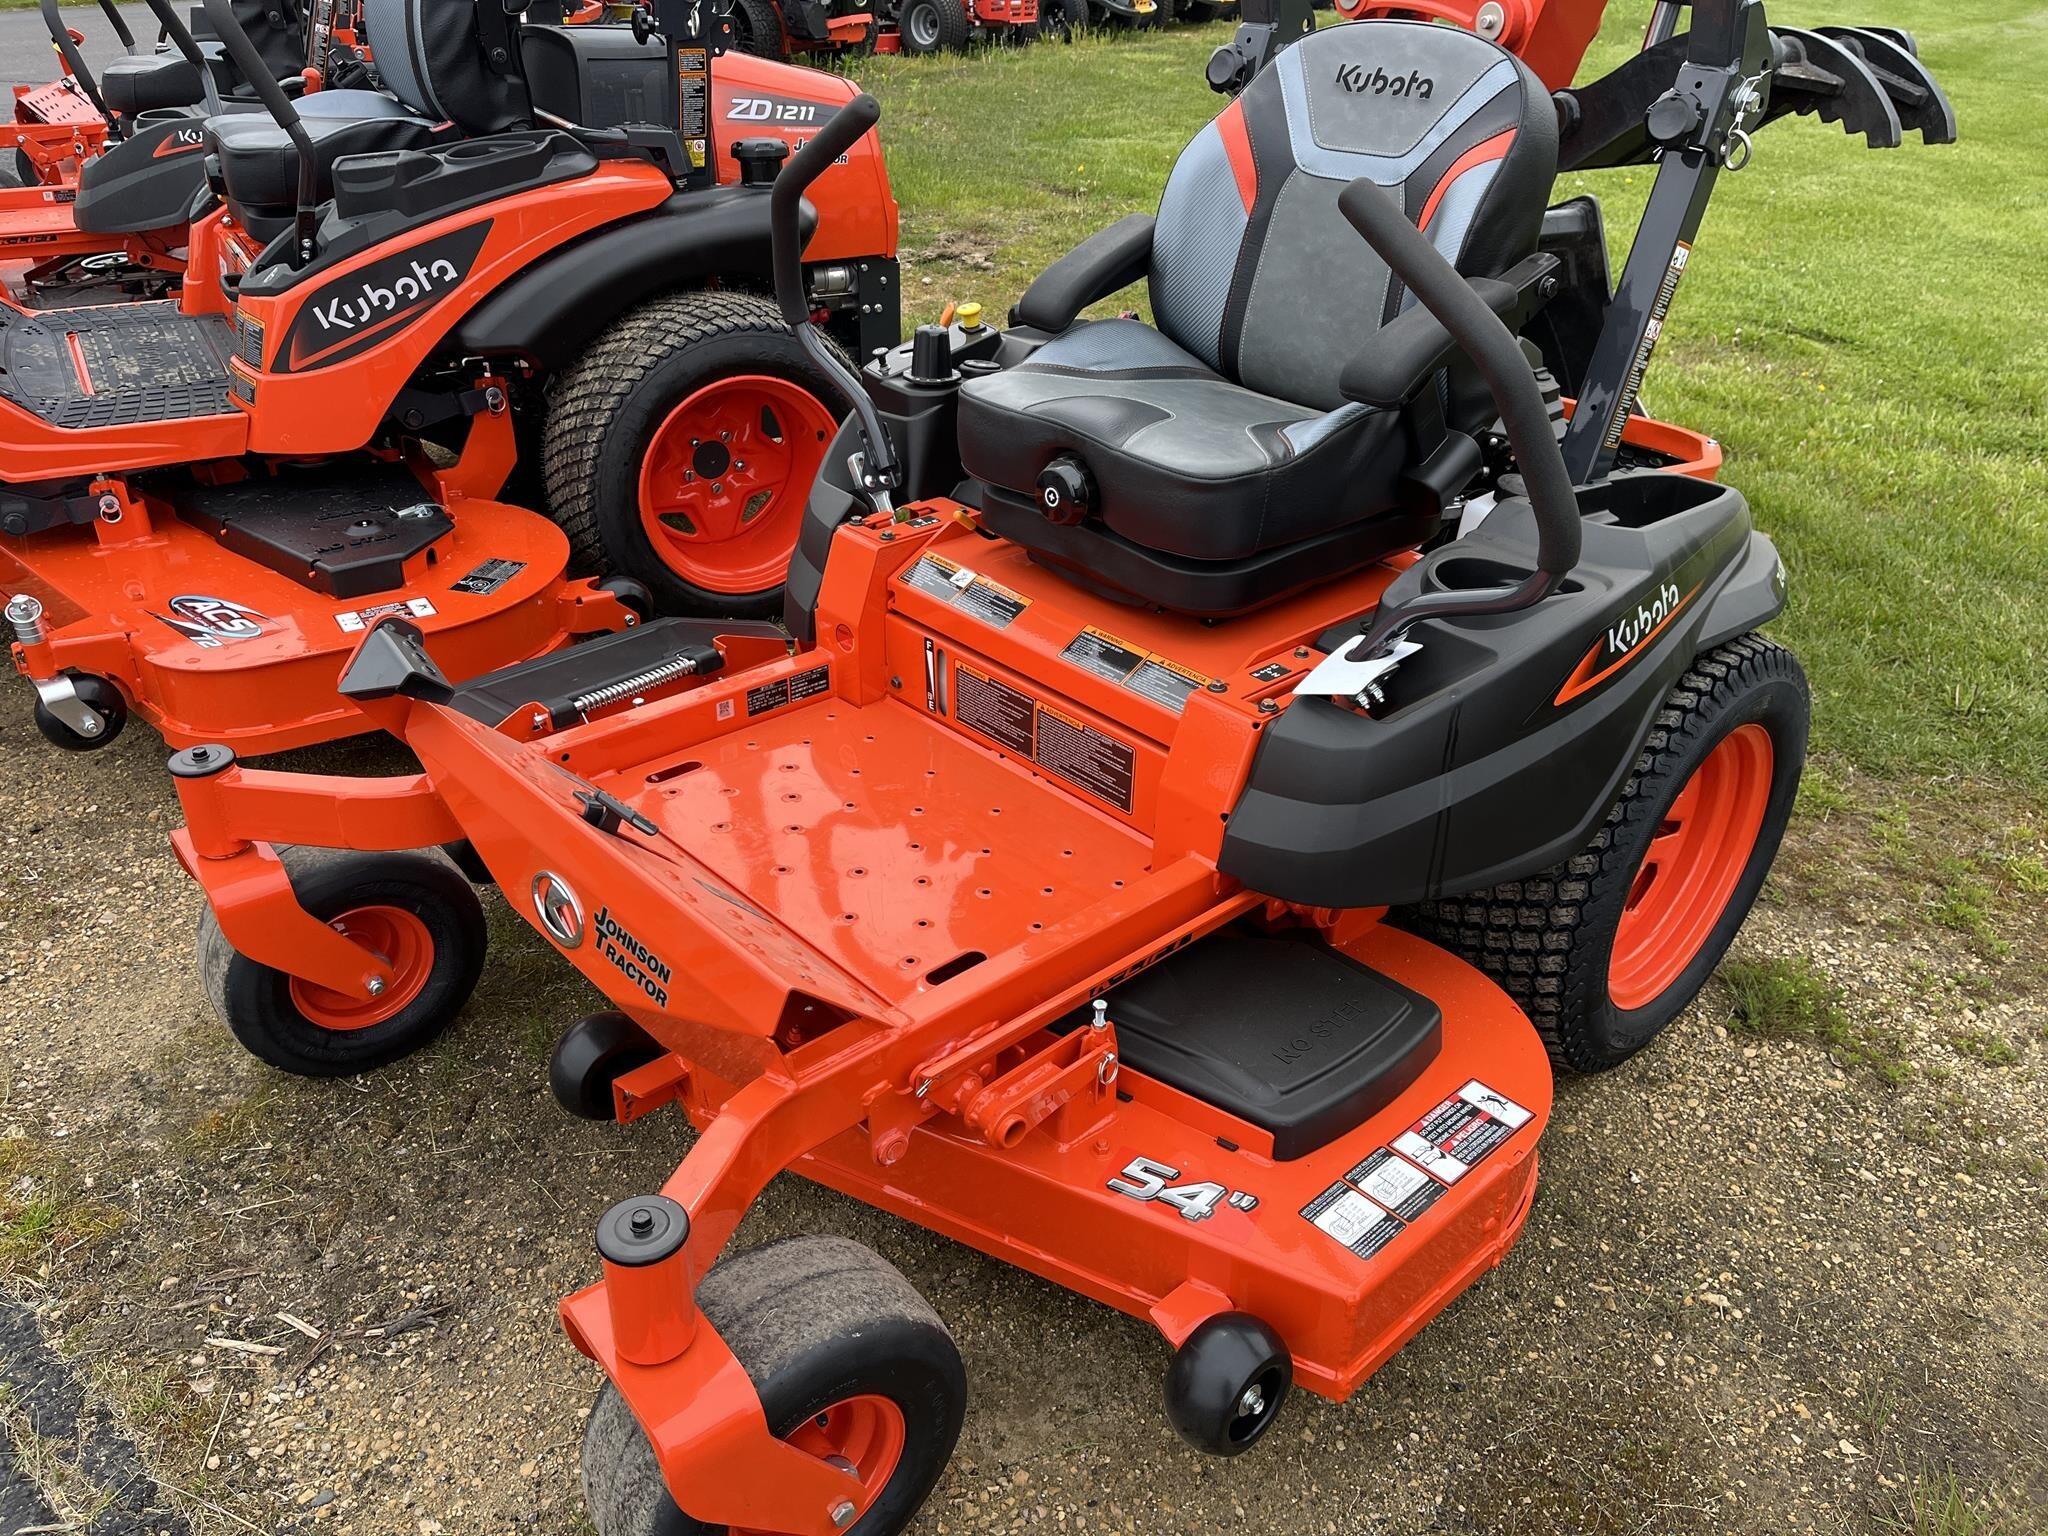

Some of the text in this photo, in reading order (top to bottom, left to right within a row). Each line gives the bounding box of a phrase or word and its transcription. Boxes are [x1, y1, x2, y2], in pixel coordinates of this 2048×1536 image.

[1335, 63, 1434, 99] Kubota
[726, 98, 816, 121] ZD 1211
[312, 259, 458, 330] Kubota
[182, 602, 259, 632] ACS
[1608, 583, 1680, 654] Kubota
[926, 640, 932, 650] F
[1098, 631, 1124, 646] WARNING
[1166, 661, 1207, 683] ADVERTENCIA
[928, 700, 935, 710] E
[1046, 707, 1081, 728] ADVERTENCIA
[594, 906, 672, 984] JOHNSON
[595, 926, 668, 1008] TRACTOR
[1272, 1039, 1313, 1065] NO
[1424, 1100, 1453, 1122] DANGER
[1454, 1117, 1485, 1141] PELIGRO
[1106, 1156, 1260, 1222] 54"
